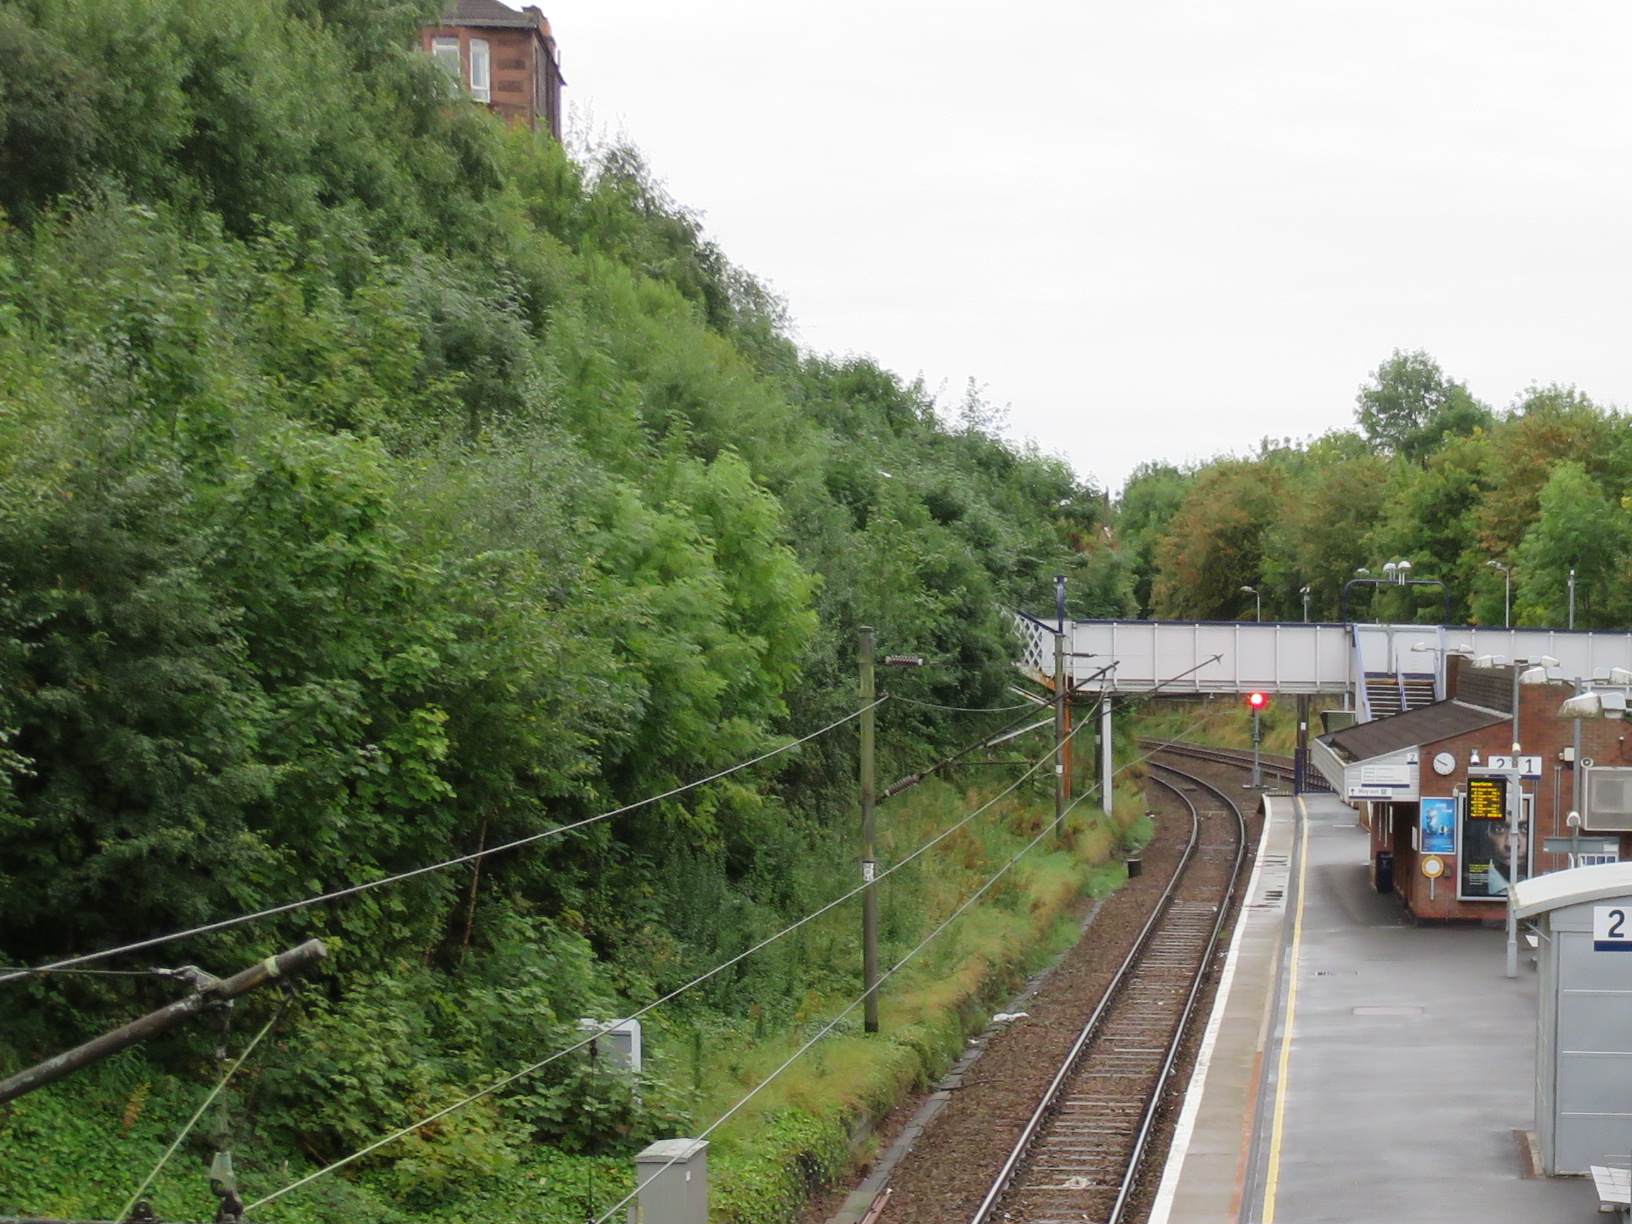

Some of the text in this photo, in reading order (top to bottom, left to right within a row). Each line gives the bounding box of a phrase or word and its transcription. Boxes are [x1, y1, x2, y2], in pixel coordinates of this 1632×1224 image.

[1496, 758, 1505, 769] 2
[1525, 759, 1533, 773] 1
[1608, 909, 1625, 938] 2
